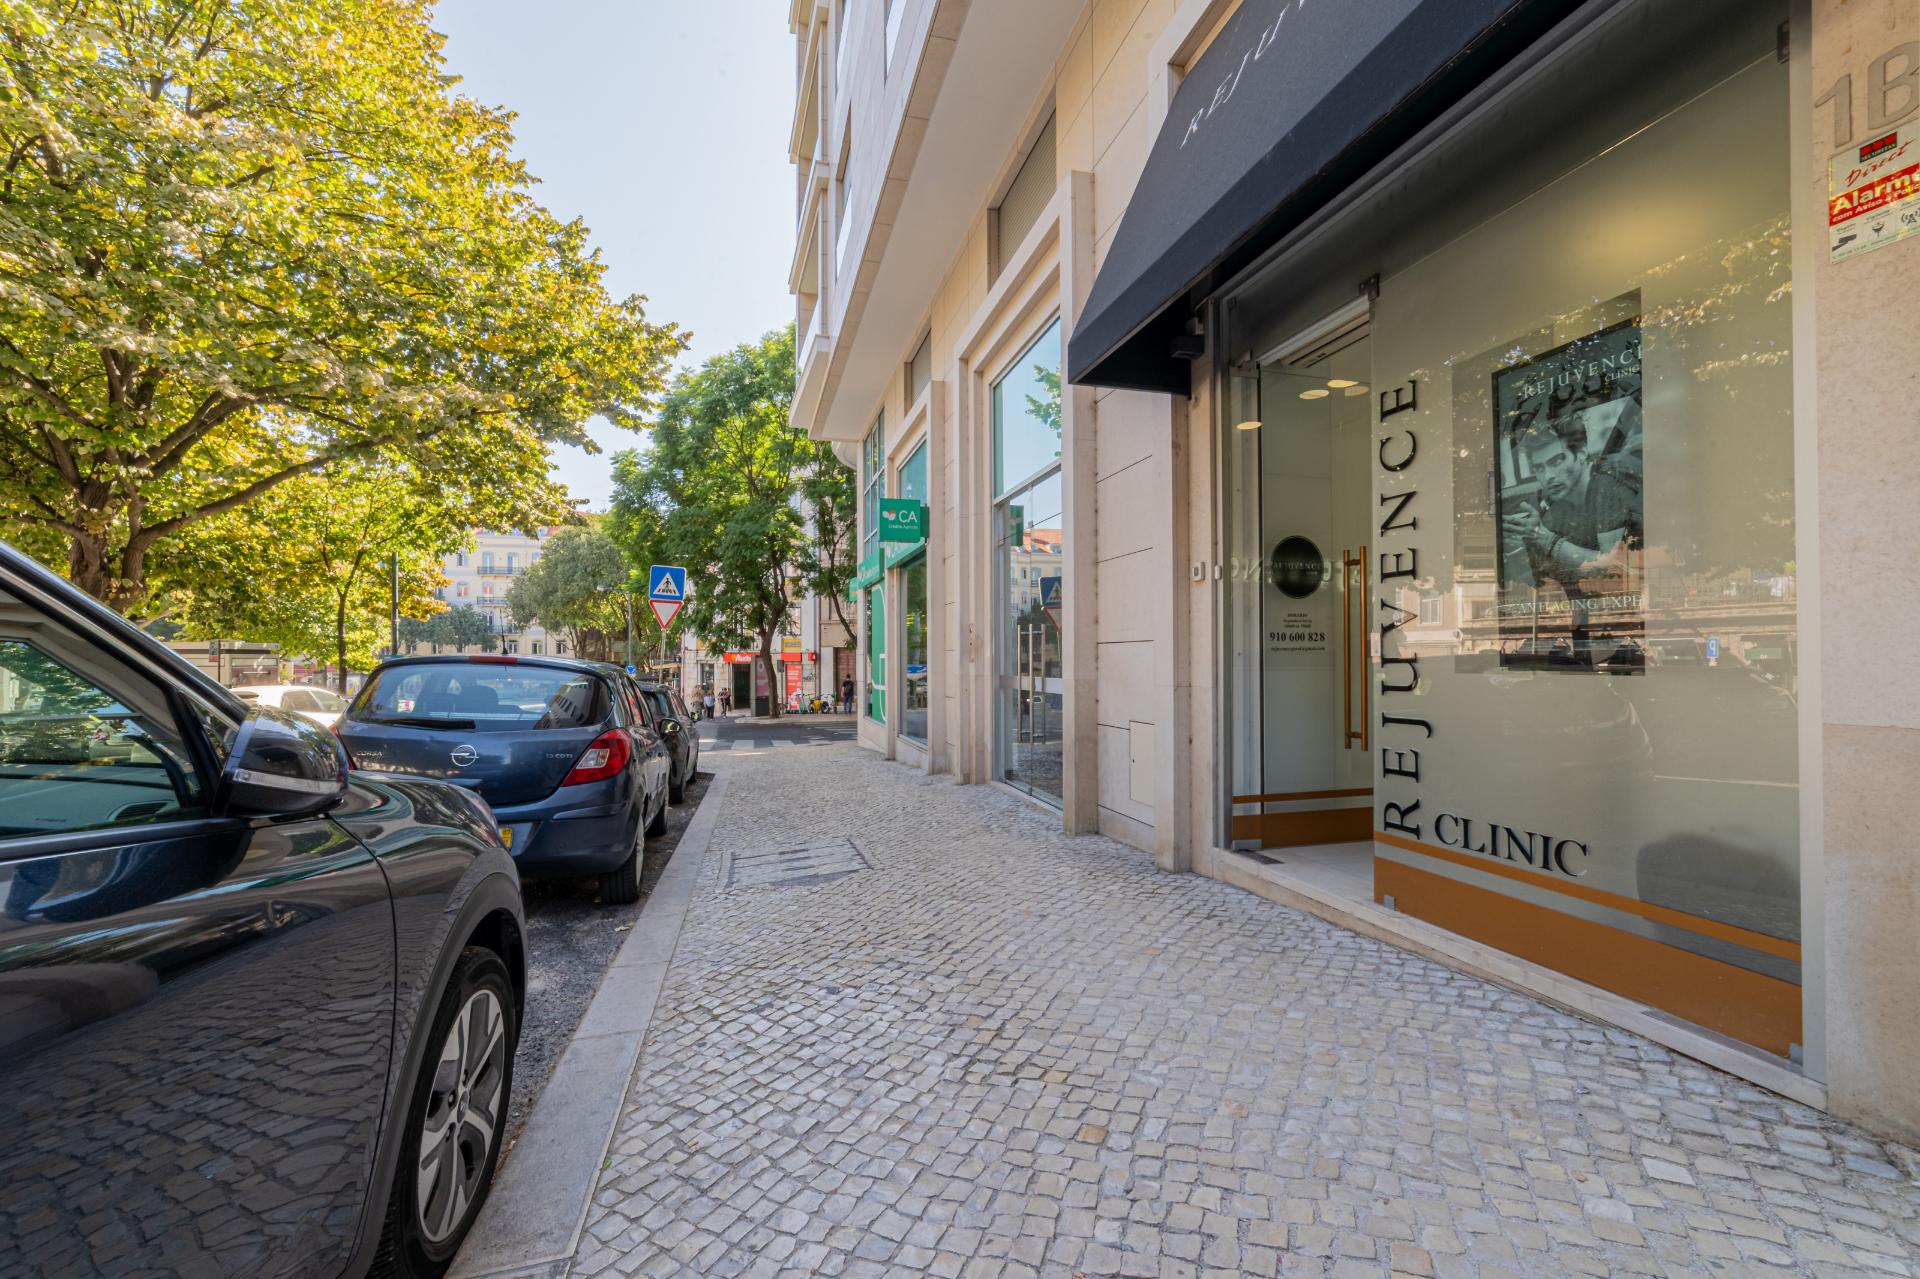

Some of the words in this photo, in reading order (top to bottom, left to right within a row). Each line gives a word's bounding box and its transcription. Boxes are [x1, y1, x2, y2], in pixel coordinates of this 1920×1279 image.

[1179, 0, 1304, 150] REJU
[898, 510, 918, 523] CA
[1269, 631, 1287, 642] 910
[1288, 631, 1306, 642] 600
[1308, 631, 1326, 642] 828
[1379, 379, 1434, 840] REJUVENCE
[1434, 813, 1590, 877] CLINIC
